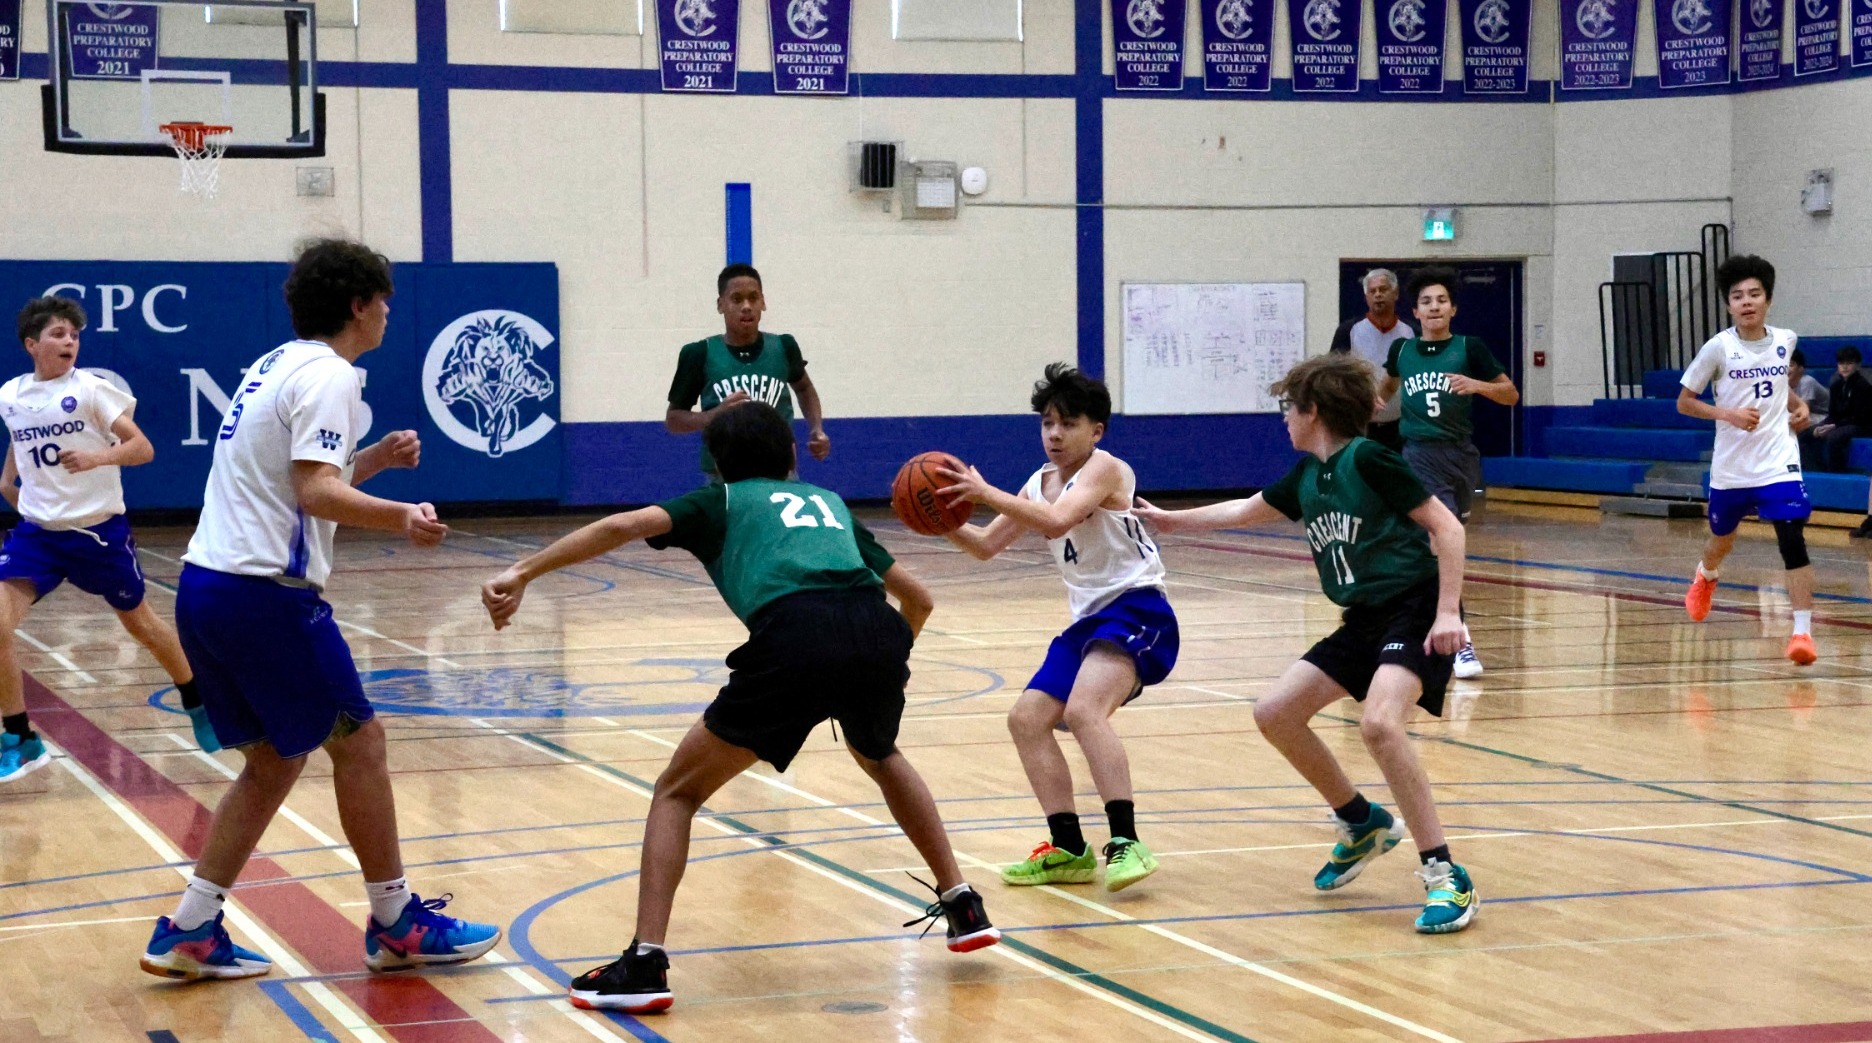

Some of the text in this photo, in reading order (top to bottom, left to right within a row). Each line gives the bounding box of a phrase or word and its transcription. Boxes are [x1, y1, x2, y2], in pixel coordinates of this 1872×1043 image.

[77, 23, 149, 35] CRESTWOOD
[73, 35, 153, 47] PREPARATORY
[667, 40, 730, 50] CRESTWOOD
[1119, 42, 1177, 51] CRESTWOOD
[1568, 41, 1628, 52] CRESTWOOD
[1664, 36, 1725, 49] CRESTWOOD
[87, 47, 141, 58] COLLEGE
[780, 43, 842, 53] CRESTWOOD
[1208, 43, 1265, 52] CRESTWOOD
[1296, 44, 1352, 53] CRESTWOOD
[1382, 45, 1437, 55] CRESTWOOD
[1467, 46, 1522, 56] CRESTWOOD
[1661, 46, 1728, 60] PREPARATORY
[664, 52, 734, 62] PREPARATORY
[776, 54, 845, 64] PREPARATORY
[1116, 52, 1181, 62] PREPARATORY
[1205, 53, 1268, 63] PREPARATORY
[1294, 55, 1356, 64] PREPARATORY
[1379, 56, 1441, 66] PREPARATORY
[1465, 57, 1525, 66] PREPARATORY
[1564, 52, 1630, 62] PREPARATORY
[96, 61, 130, 75] 2021
[675, 63, 723, 73] COLLEGE
[1127, 63, 1170, 73] COLLEGE
[1216, 64, 1258, 74] COLLEGE
[1575, 62, 1619, 72] COLLEGE
[1672, 58, 1718, 70] COLLEGE
[787, 65, 834, 75] COLLEGE
[1304, 65, 1345, 75] COLLEGE
[1388, 67, 1430, 76] COLLEGE
[1474, 67, 1515, 76] COLLEGE
[683, 75, 713, 88] 2021
[1138, 75, 1160, 86] 2022
[1226, 76, 1248, 87] 2022
[1573, 73, 1620, 85] 2022-2023
[1684, 71, 1706, 82] 2023
[796, 77, 825, 90] 2021
[1315, 77, 1335, 88] 2022
[1400, 78, 1420, 89] 2022
[1473, 78, 1516, 89] 2022-2023
[1404, 371, 1454, 396] CRESCEN
[712, 374, 785, 408] CRESCENT
[1752, 380, 1773, 399] 13
[1425, 392, 1441, 417] 5
[12, 420, 85, 442] RESTWOOD
[28, 442, 62, 469] 10
[769, 492, 845, 530] 21
[1306, 511, 1363, 553] CRESCENT
[1063, 537, 1078, 565] 4
[1331, 545, 1355, 586] 11
